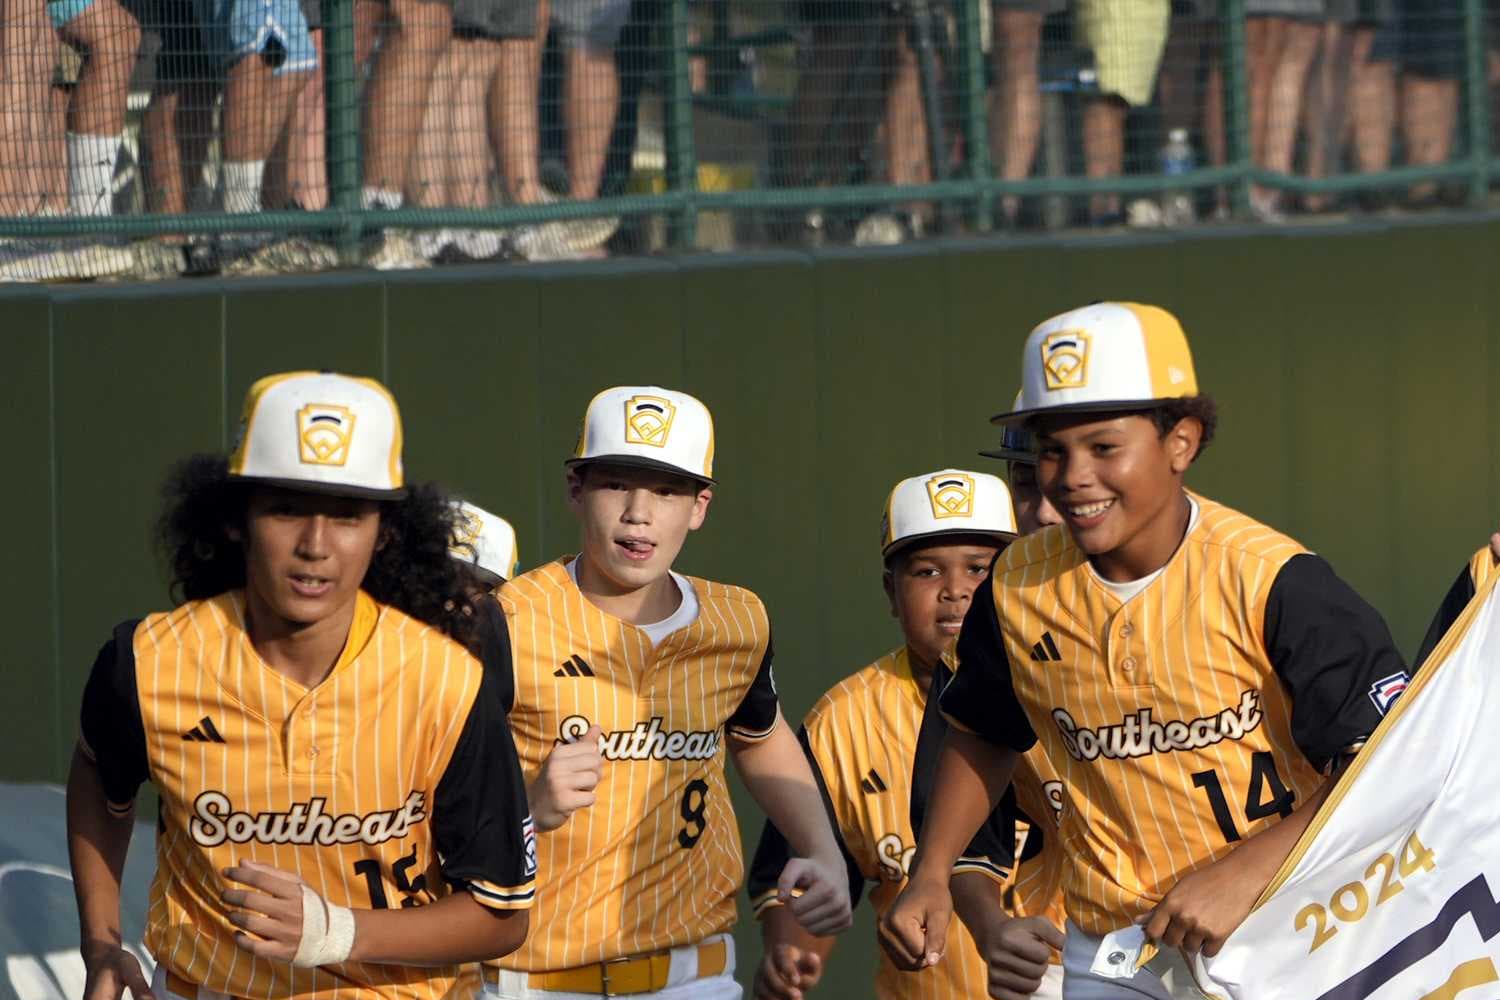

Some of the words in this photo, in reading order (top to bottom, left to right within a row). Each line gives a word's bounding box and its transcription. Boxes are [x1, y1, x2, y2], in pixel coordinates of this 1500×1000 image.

[1052, 689, 1264, 762] Southeast
[190, 790, 427, 847] Southeast
[678, 779, 709, 849] 9
[1191, 751, 1296, 844] 14
[1294, 830, 1437, 955] 2024
